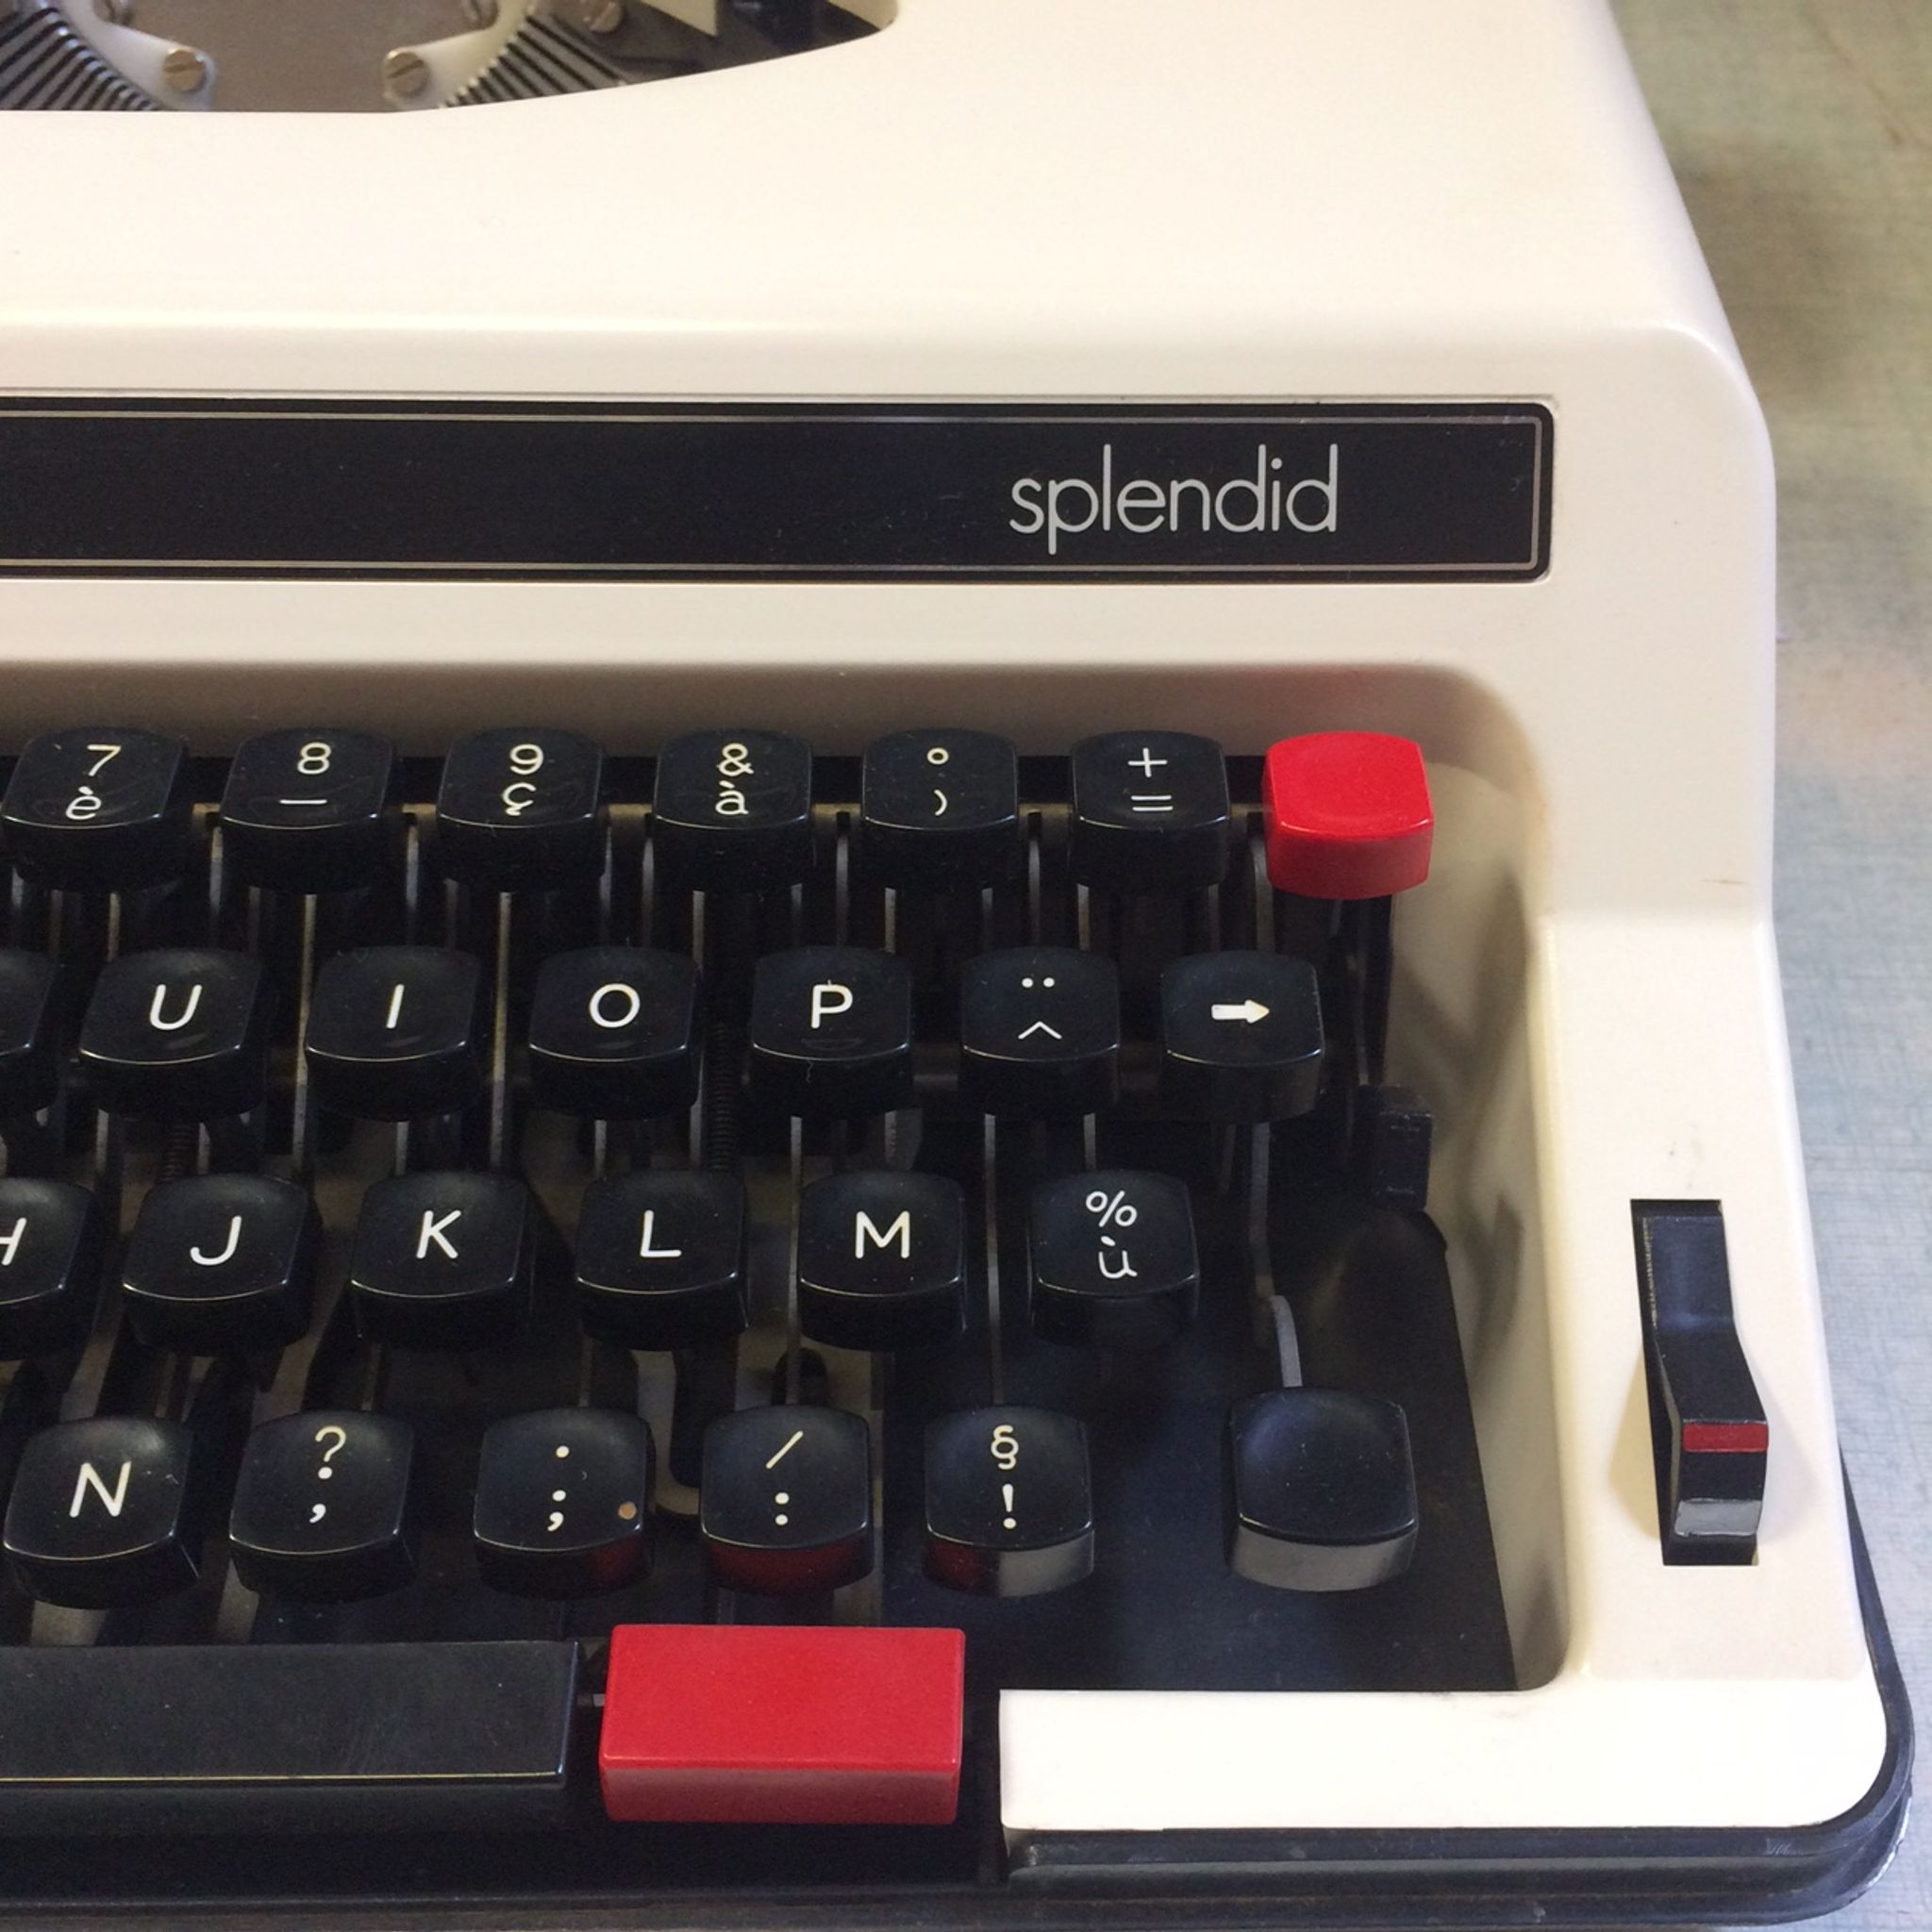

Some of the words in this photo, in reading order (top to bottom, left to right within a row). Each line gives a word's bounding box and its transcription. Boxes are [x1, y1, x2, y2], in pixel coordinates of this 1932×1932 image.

[1009, 443, 1338, 555] splendid
[87, 744, 122, 776] 7
[297, 741, 331, 774] 8
[509, 743, 544, 775] 9
[717, 742, 754, 777] &
[1127, 747, 1168, 778] +
[65, 786, 102, 820] è
[502, 782, 537, 816] ç
[715, 780, 749, 815] à
[1130, 795, 1174, 812] =
[149, 984, 203, 1030] U
[386, 984, 405, 1029] I
[589, 983, 641, 1028] O
[810, 984, 854, 1029] P
[1085, 1190, 1138, 1227] %
[190, 1215, 242, 1266] J
[416, 1209, 461, 1259] K
[640, 1209, 682, 1257] L
[855, 1210, 910, 1259] M
[1098, 1236, 1138, 1279] ù
[315, 1425, 347, 1479] ?
[69, 1460, 132, 1518] N
[1002, 1483, 1017, 1529] !
